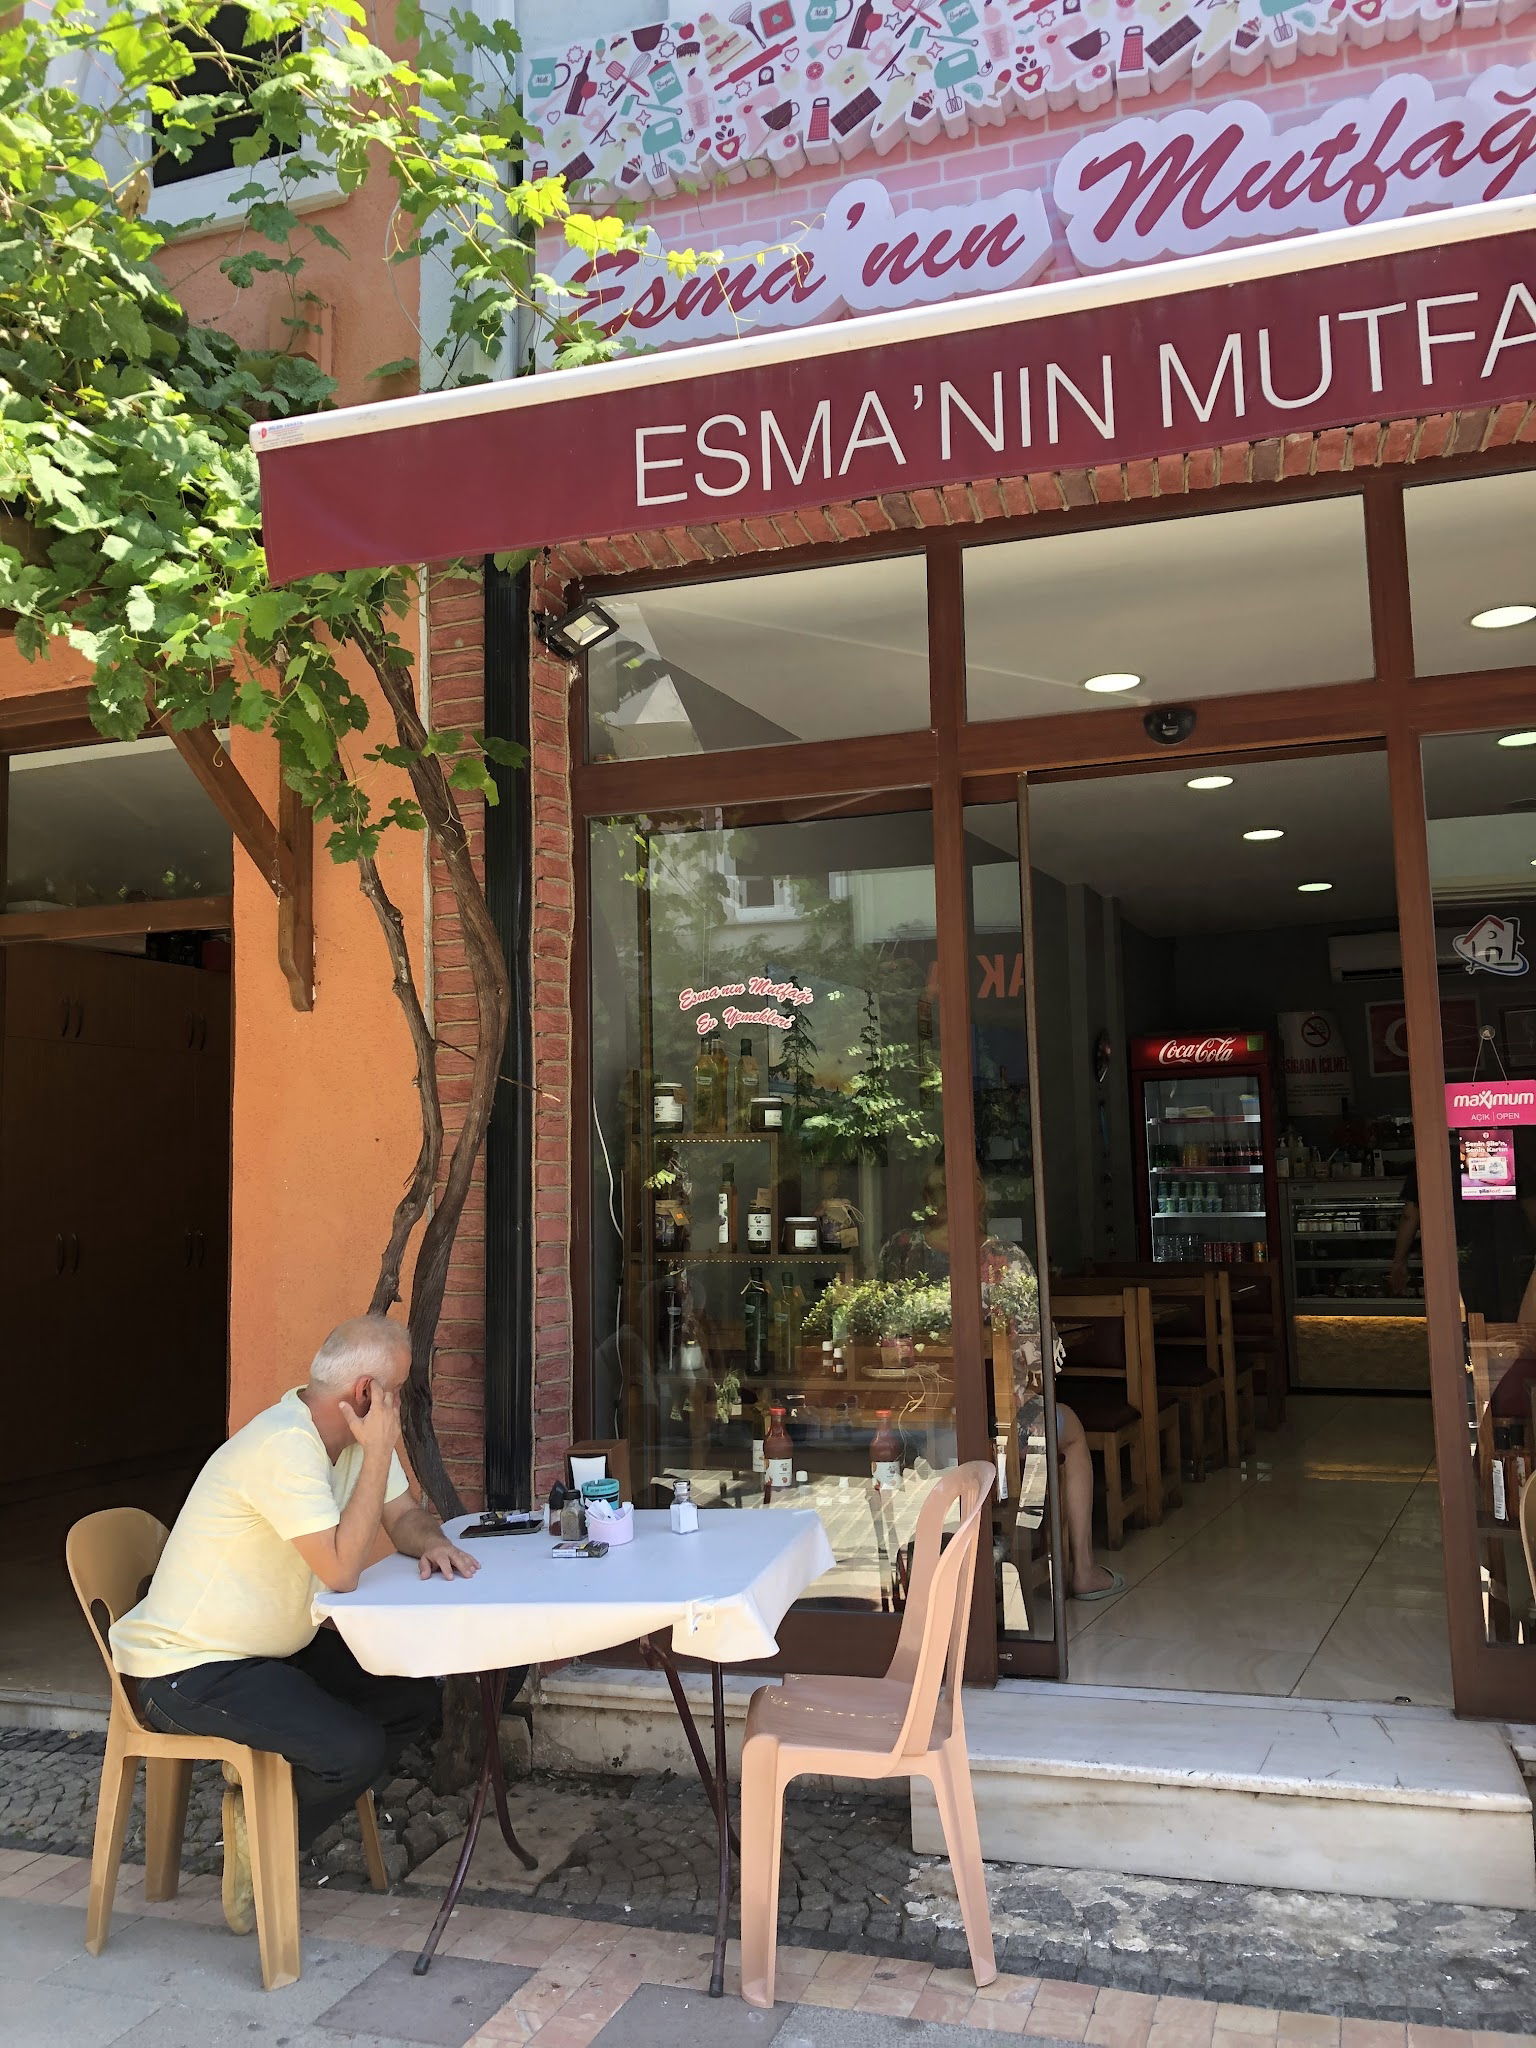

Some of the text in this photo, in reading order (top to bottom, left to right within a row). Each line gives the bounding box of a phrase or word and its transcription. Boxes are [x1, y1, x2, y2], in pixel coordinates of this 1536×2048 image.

[656, 75, 675, 91] Sugar
[635, 282, 1536, 507] ESMA'NIN MUTFA
[697, 1007, 796, 1034] Ev Yemekleri
[1158, 1037, 1237, 1065] Coca-Cola
[1471, 1112, 1520, 1122] AÇIK OPEN
